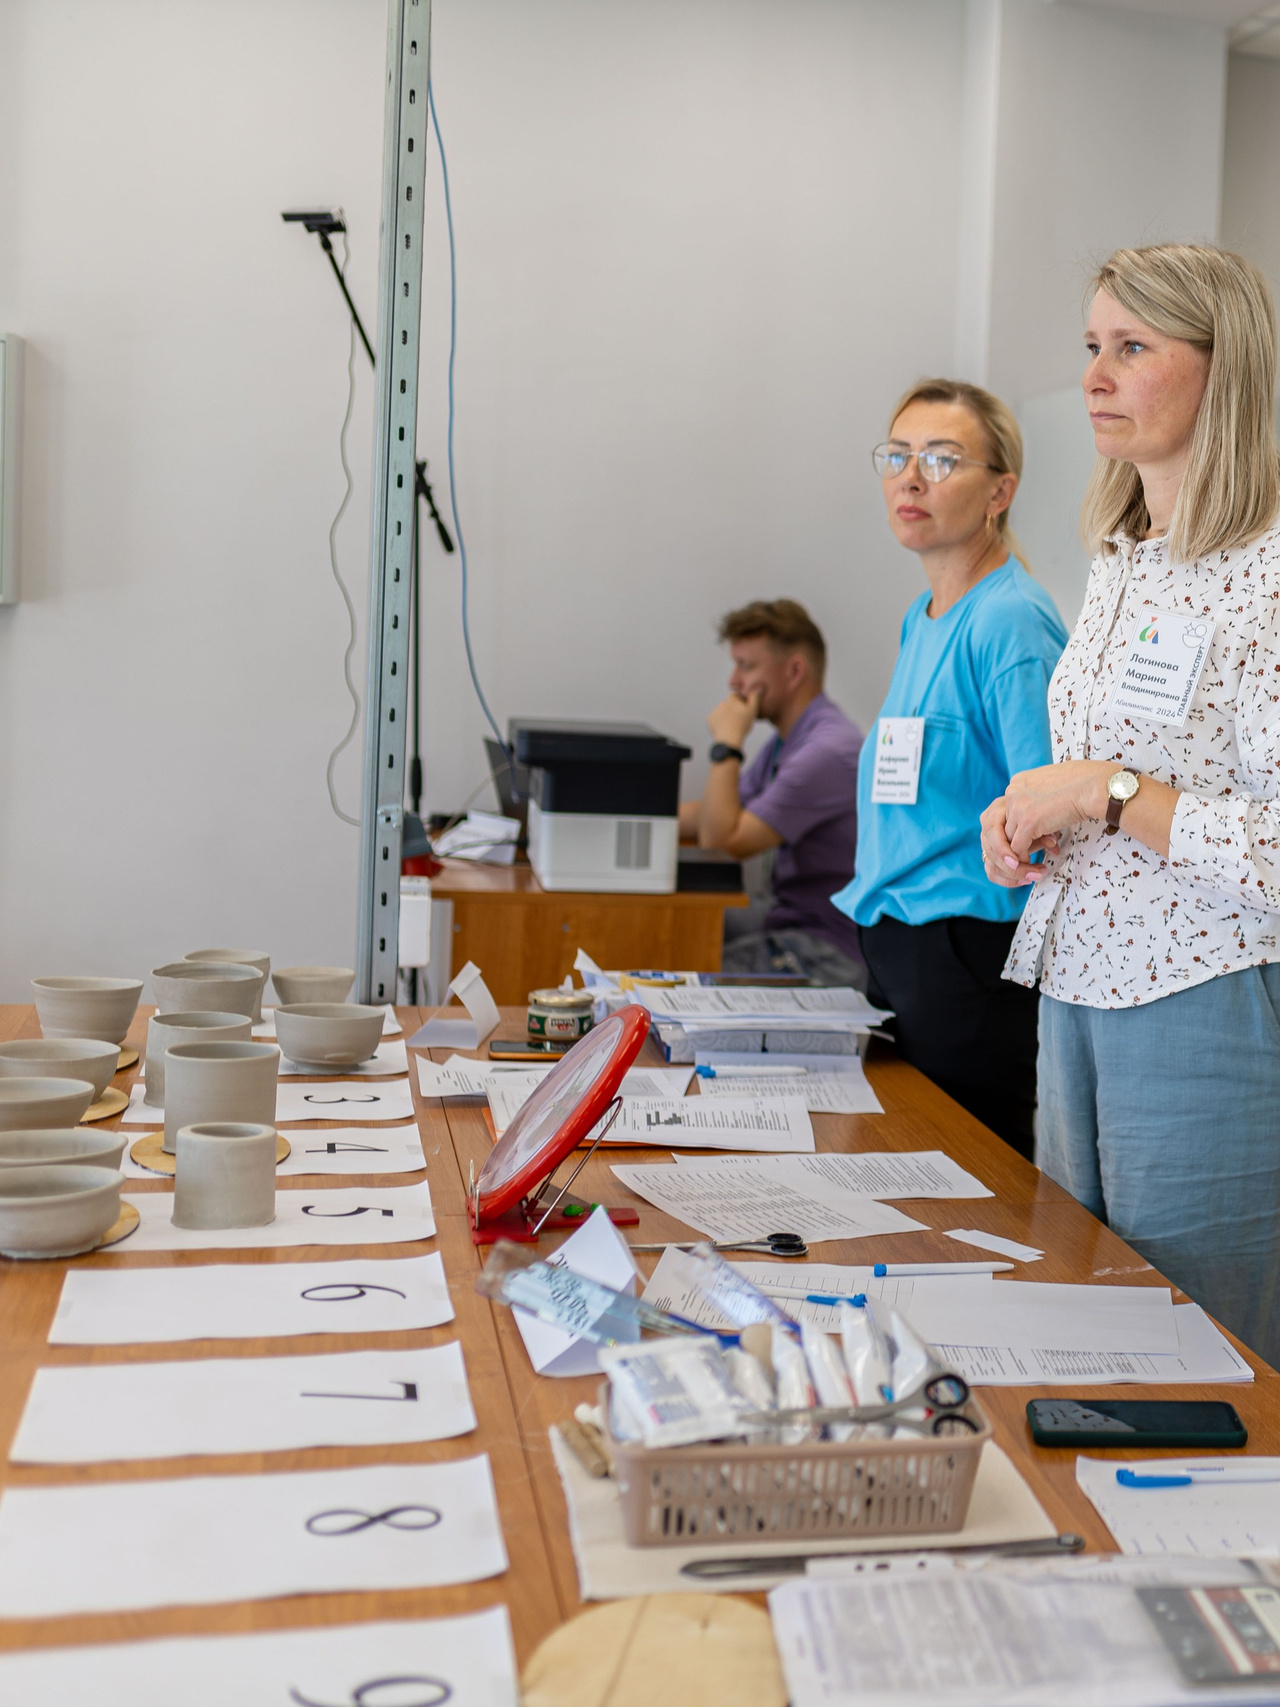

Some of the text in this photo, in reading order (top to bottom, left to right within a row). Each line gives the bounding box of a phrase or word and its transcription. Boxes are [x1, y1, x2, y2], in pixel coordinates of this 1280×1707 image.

[1130, 653, 1179, 672] Логинова
[1125, 667, 1167, 685] Марина
[1177, 645, 1205, 717] ГЛАВНЫЙ ЭКСПЕРТ
[1121, 681, 1181, 702] Владимировна
[1156, 707, 1176, 718] 2024
[303, 1094, 382, 1104] 3
[305, 1142, 389, 1154] 4
[301, 1205, 394, 1218] 5
[301, 1284, 406, 1301] 6
[299, 1380, 418, 1402] 7
[305, 1505, 442, 1537] 8
